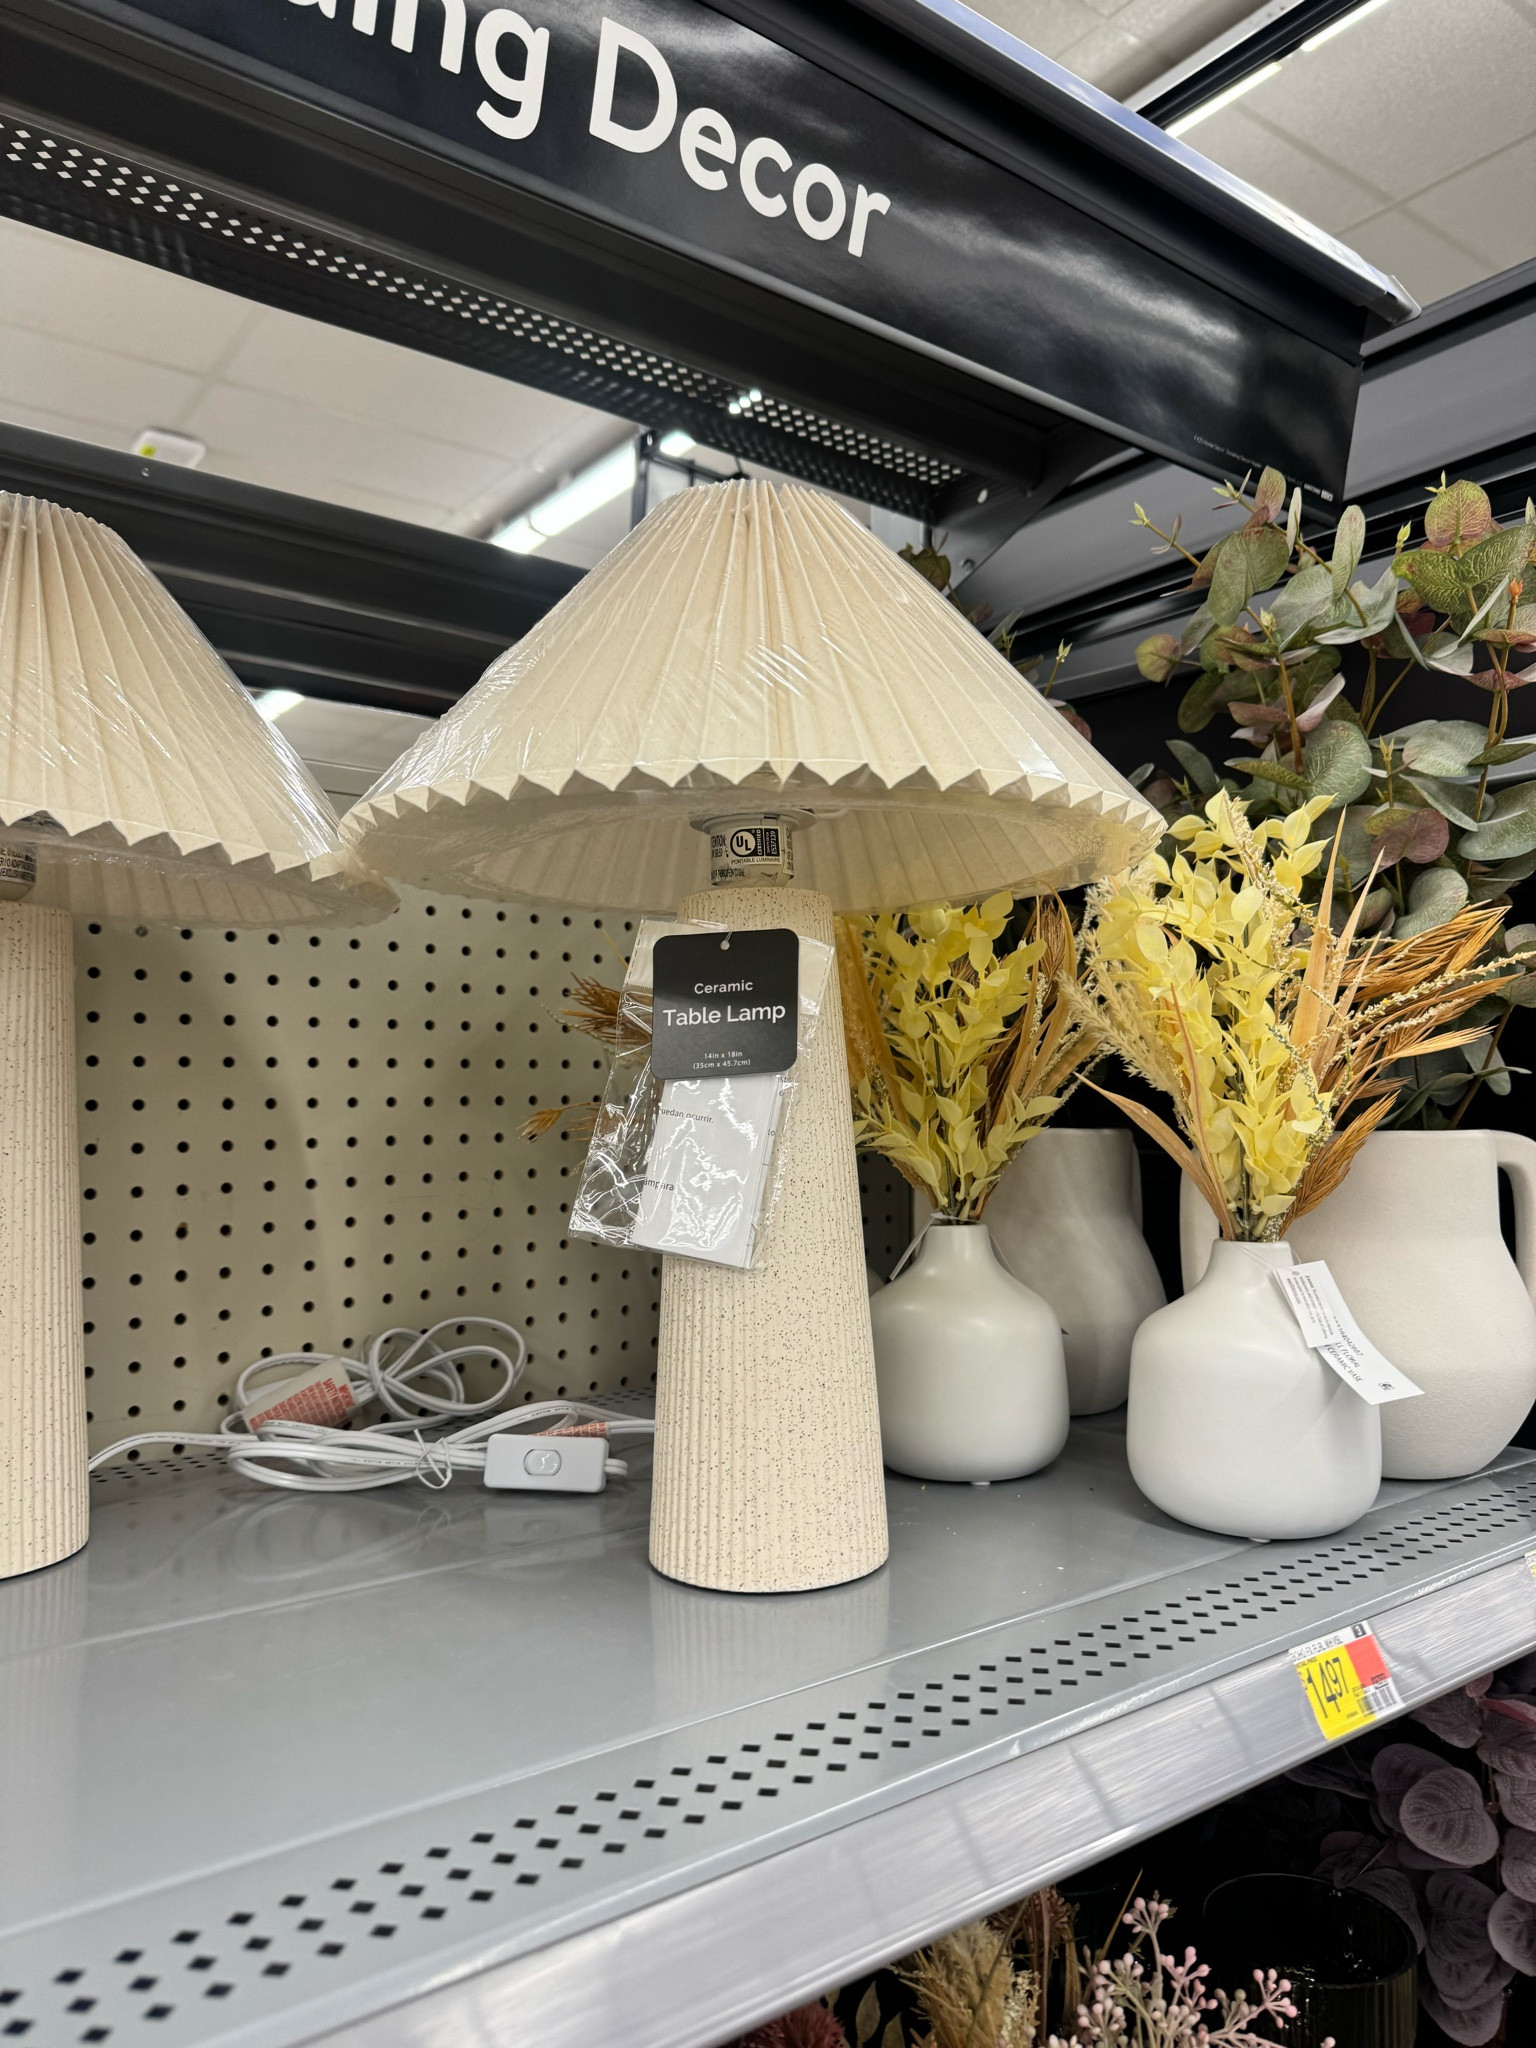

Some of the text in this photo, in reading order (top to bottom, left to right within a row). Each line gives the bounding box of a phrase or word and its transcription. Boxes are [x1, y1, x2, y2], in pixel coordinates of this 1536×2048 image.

[588, 17, 892, 258] Decor
[694, 980, 754, 995] Ceramic
[662, 1004, 786, 1026] Table Lamp
[693, 1061, 715, 1070] (35cm
[722, 1058, 751, 1068] 45.7cm)
